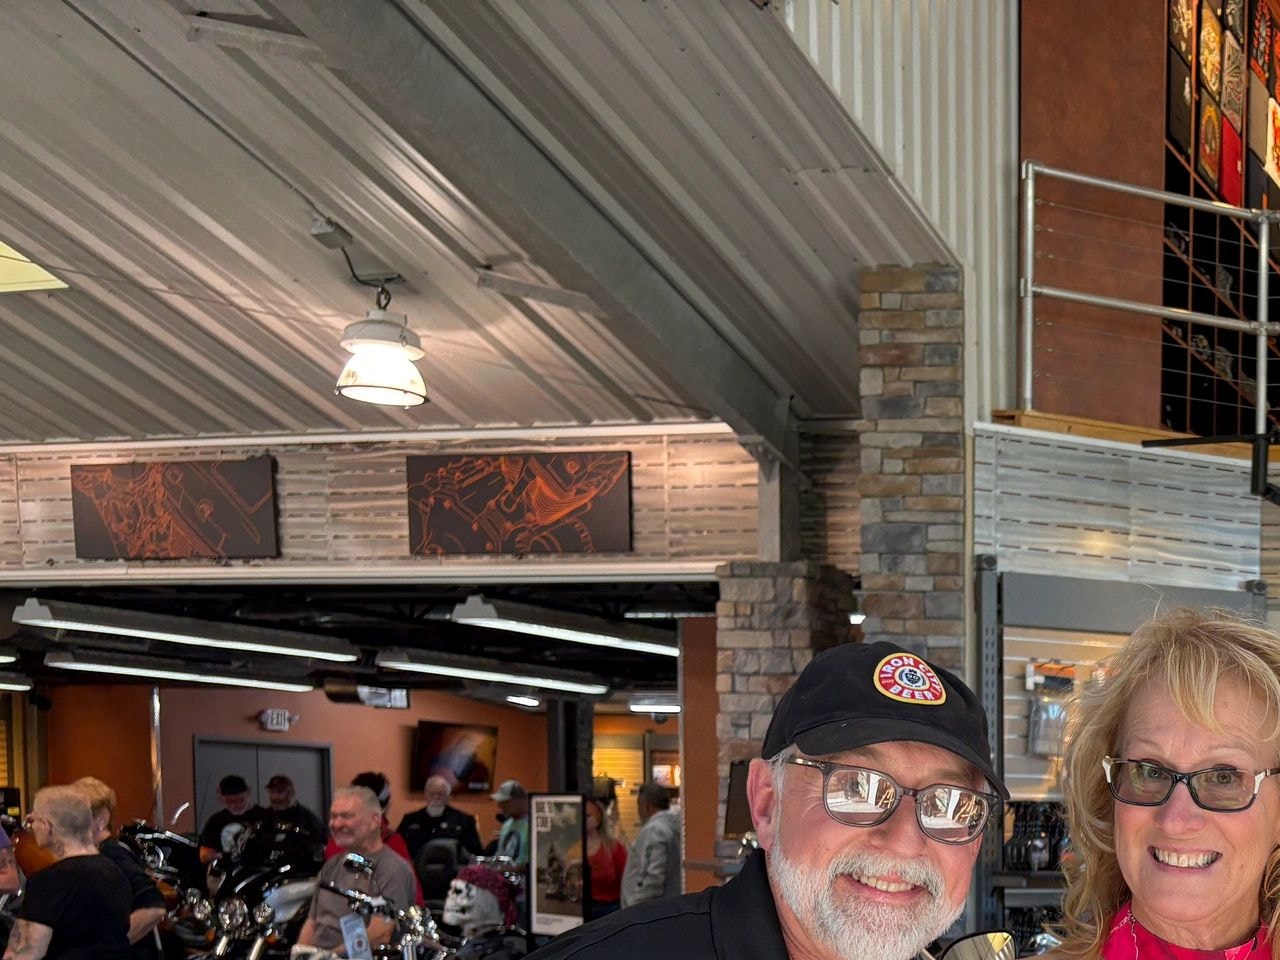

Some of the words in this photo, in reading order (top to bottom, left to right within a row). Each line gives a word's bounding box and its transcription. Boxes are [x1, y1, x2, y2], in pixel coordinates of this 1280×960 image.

[880, 656, 914, 678] IRON
[918, 663, 943, 692] CITY
[889, 684, 935, 700] BEER
